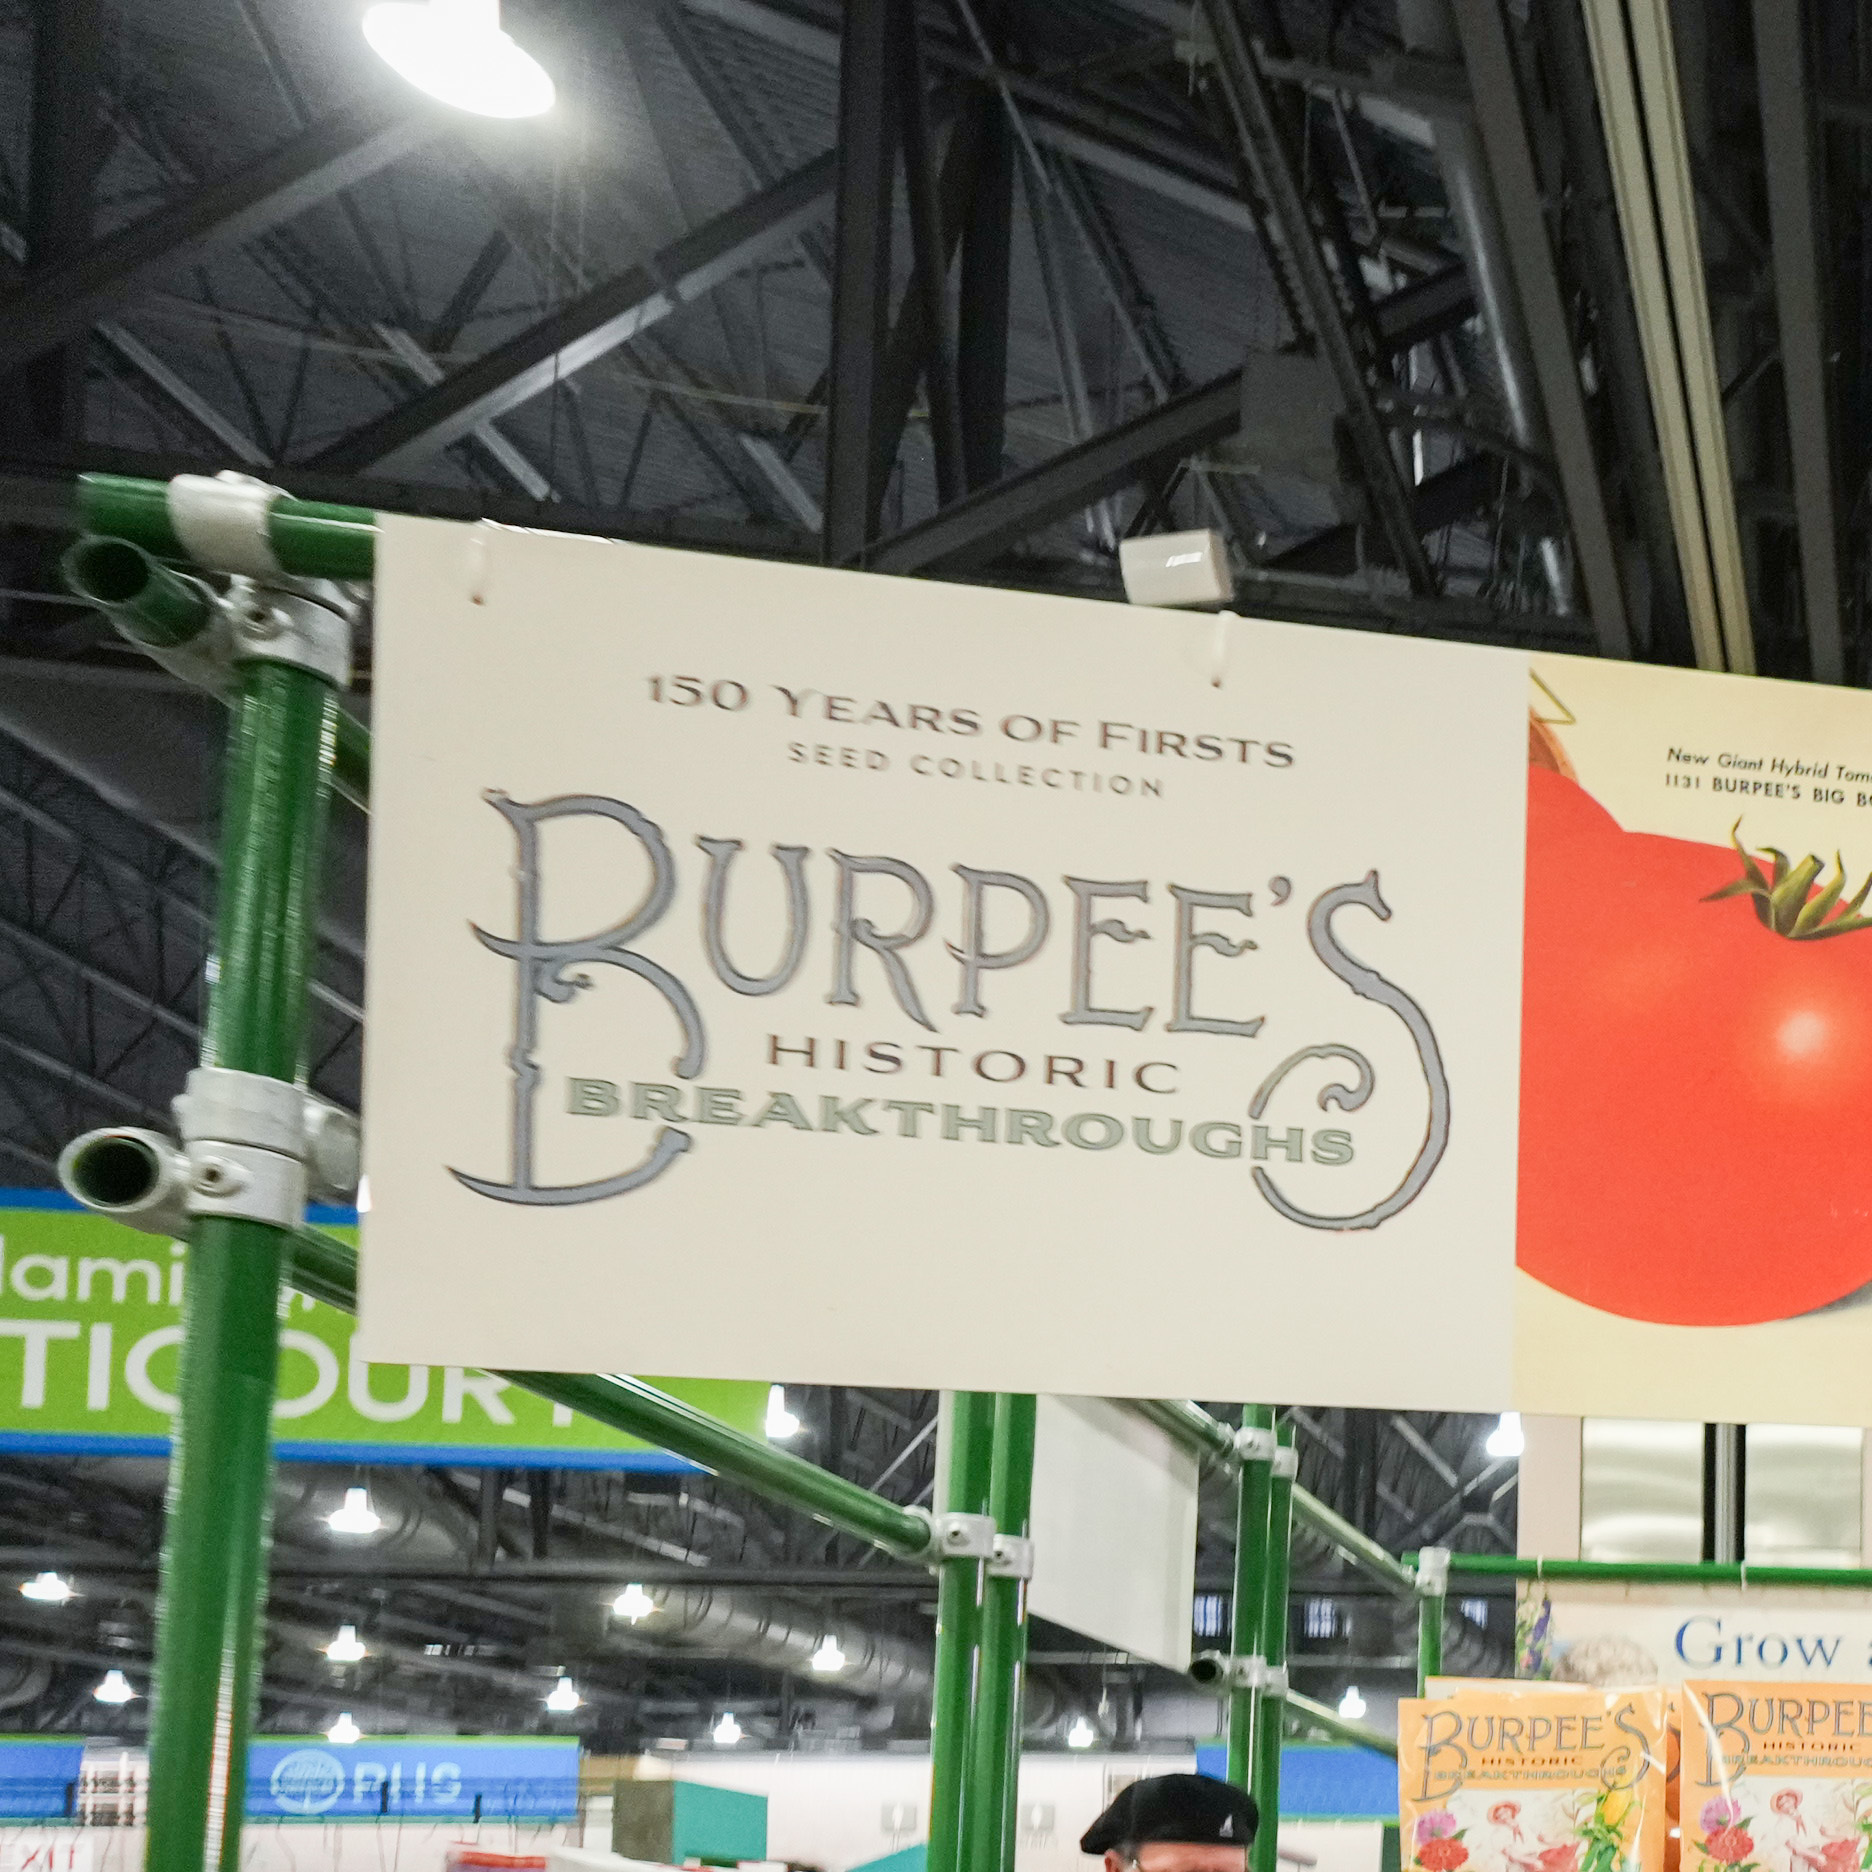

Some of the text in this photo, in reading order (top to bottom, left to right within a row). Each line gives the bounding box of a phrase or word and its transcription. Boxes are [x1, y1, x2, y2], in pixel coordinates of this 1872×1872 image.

[647, 675, 1296, 769] 150 YEARS OF FIRSTS
[788, 741, 1165, 797] SEED COLLECTION
[1666, 773, 1700, 789] 1131
[1712, 777, 1801, 799] BURPEE'S
[1813, 787, 1845, 804] BIG
[1667, 748, 1709, 765] New
[1718, 752, 1763, 771] Giant
[1771, 758, 1829, 778] Hybrid
[445, 789, 1451, 1231] BURPEE'S
[766, 1032, 1181, 1094] HISTORIC
[567, 1076, 1355, 1165] BREAKTHROUGHS
[1674, 1614, 1841, 1670] Grow
[1412, 1702, 1651, 1801] BURPEE'S
[1481, 1756, 1583, 1767] HISTORIC
[1763, 1741, 1862, 1753] HISTORIC
